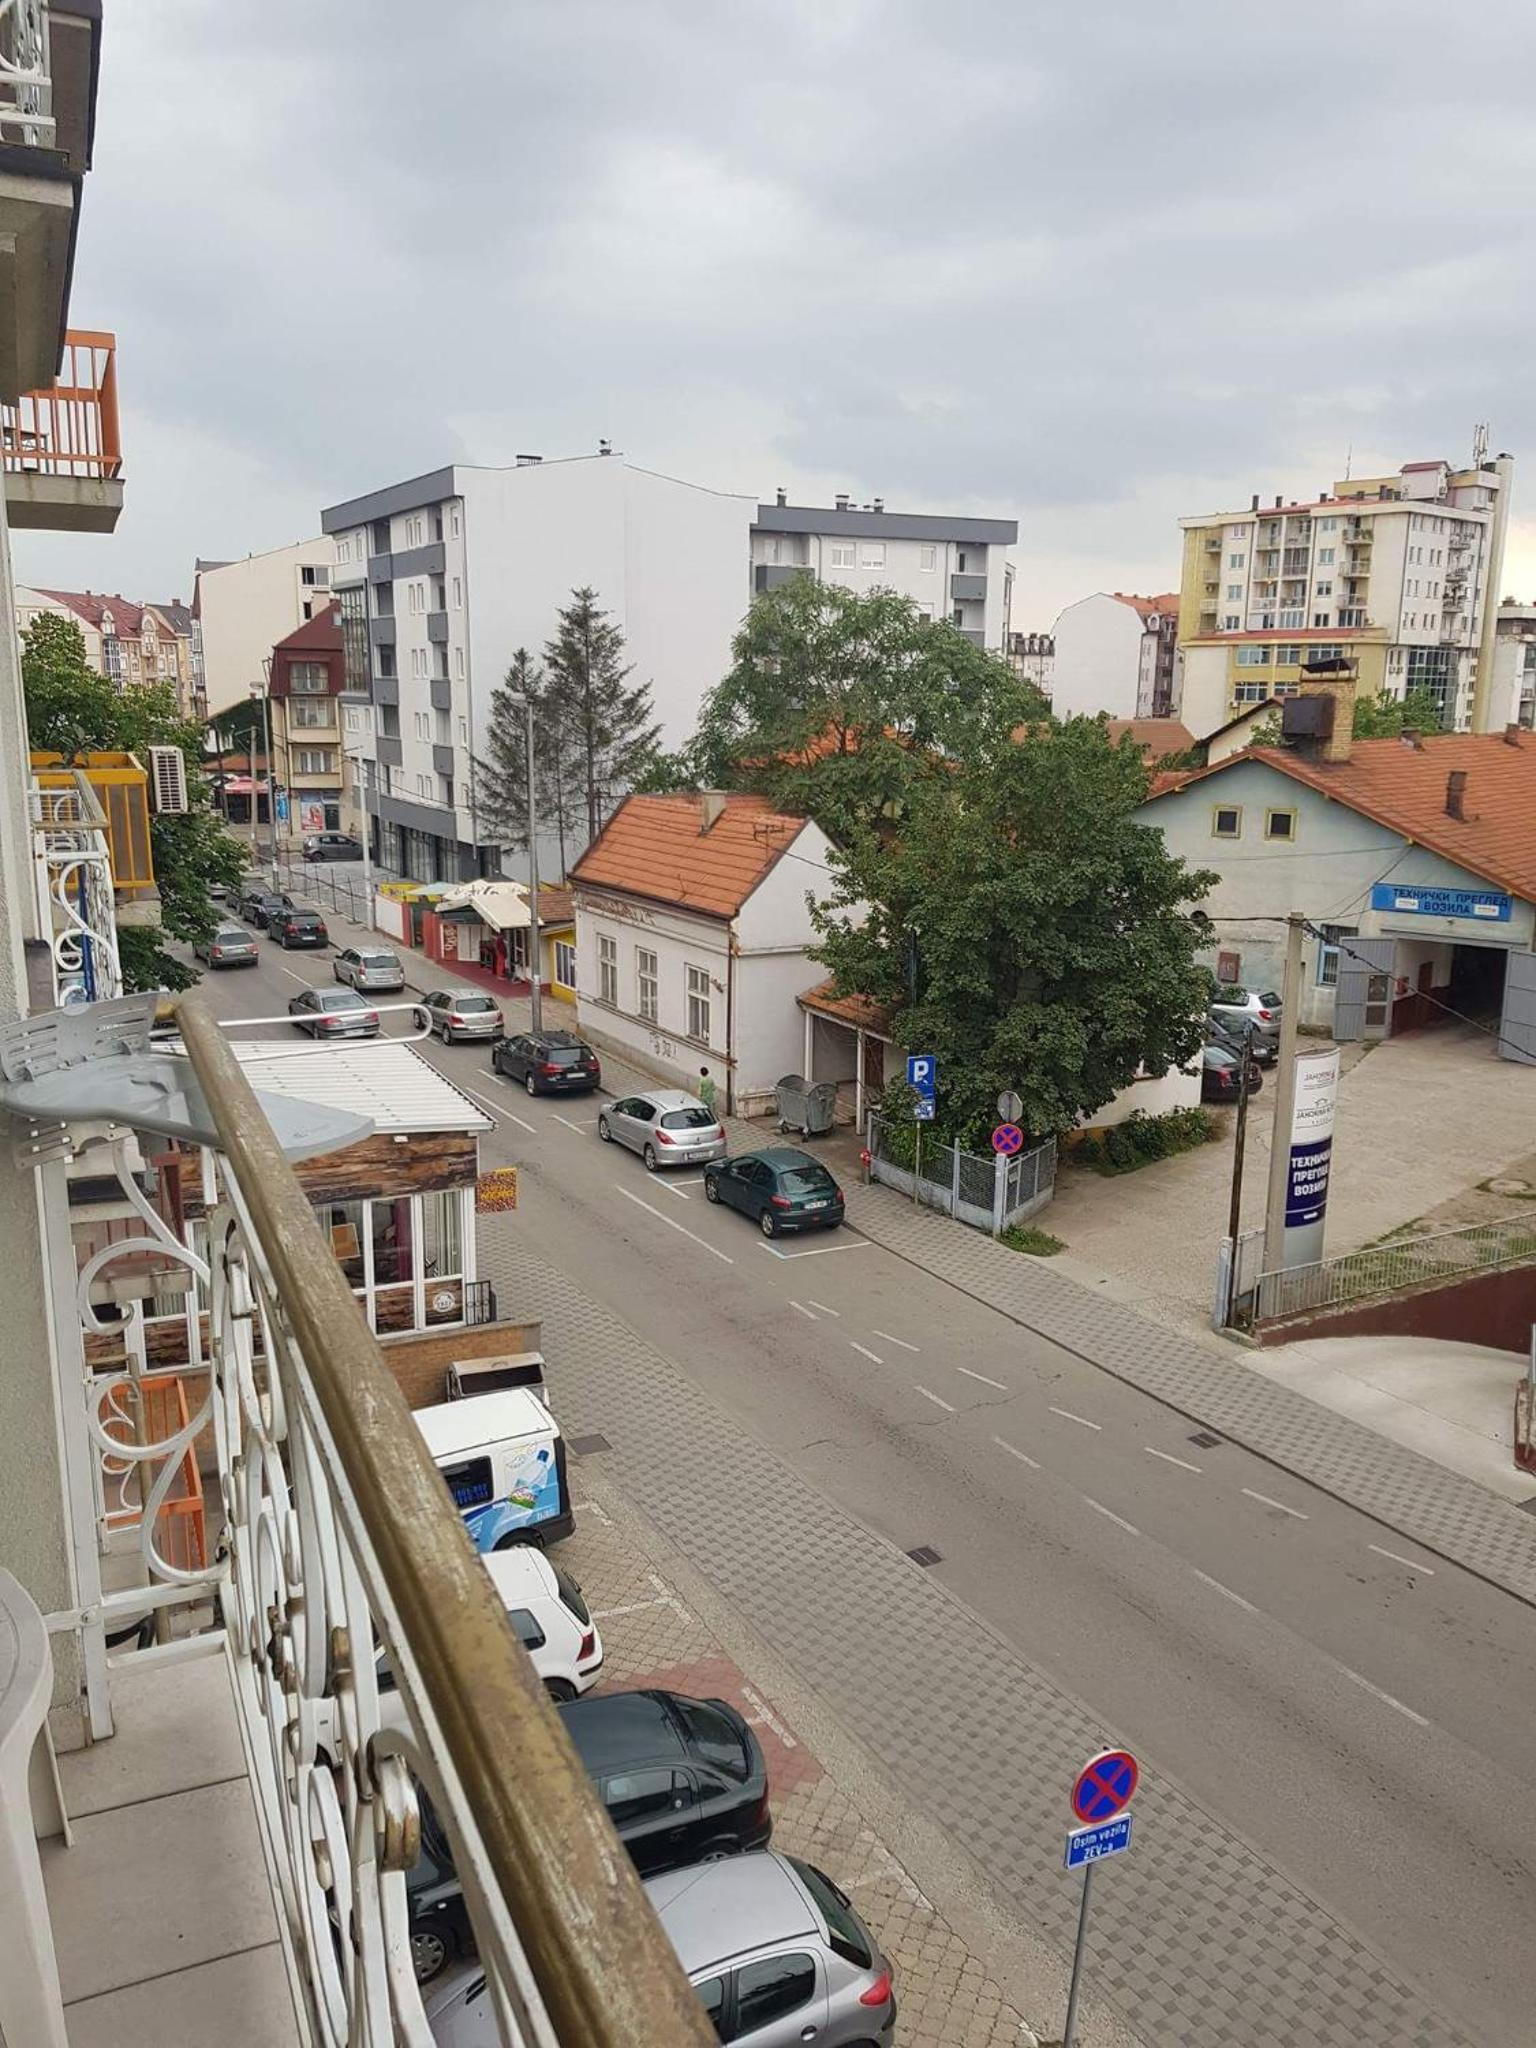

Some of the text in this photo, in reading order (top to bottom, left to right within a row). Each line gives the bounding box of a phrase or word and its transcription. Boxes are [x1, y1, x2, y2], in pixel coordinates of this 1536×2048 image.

[1393, 887, 1508, 907] ТЕХНИЧКИ ПРЕГЛЕД
[1424, 902, 1471, 914] ВОЗИЛА
[914, 1060, 929, 1083] P
[1073, 1834, 1097, 1849] Osim
